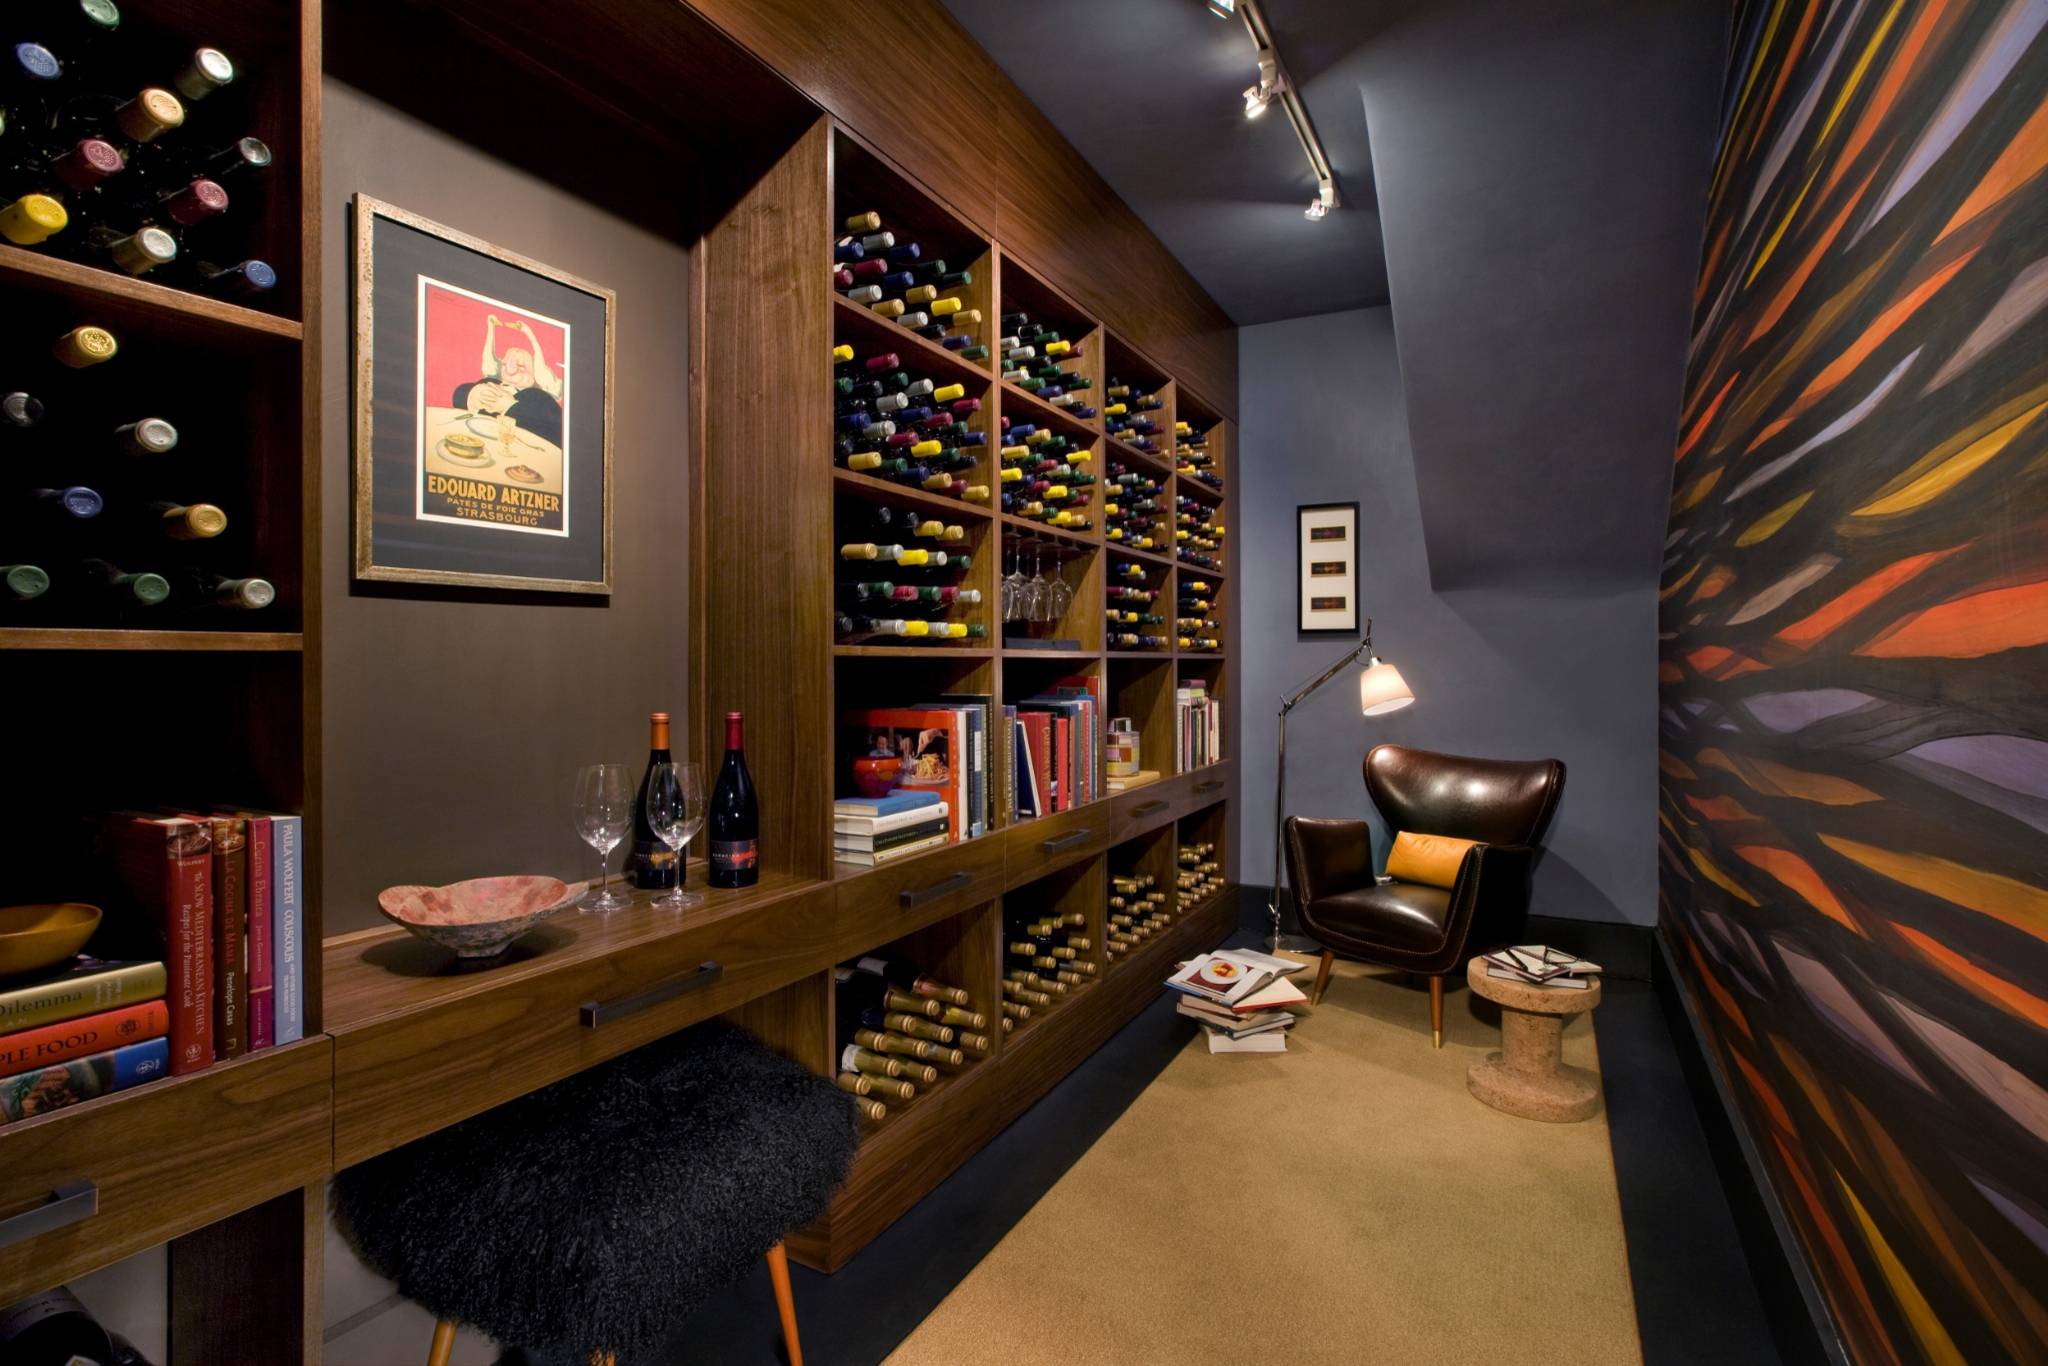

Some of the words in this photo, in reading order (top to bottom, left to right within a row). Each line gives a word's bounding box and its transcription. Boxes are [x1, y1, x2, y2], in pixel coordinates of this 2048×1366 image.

[428, 475, 496, 501] EDOUARD
[501, 487, 559, 512] ARTZNER
[456, 507, 537, 526] STRASBOURG
[480, 502, 493, 511] DE
[496, 505, 517, 514] FOIE
[519, 507, 545, 518] GRAS
[283, 824, 294, 856] PAULA
[255, 841, 266, 876] Cucina
[195, 882, 206, 909] SLOW
[225, 876, 236, 914] COCINA
[283, 858, 294, 905] WOLFERT
[255, 879, 266, 918] Ebraica
[179, 904, 193, 930] Recipes
[181, 929, 194, 943] for
[183, 943, 193, 955] the
[195, 911, 206, 990] MEDITERRANEAN
[284, 909, 295, 963] COUSCOUS
[183, 955, 193, 989] Passionate
[225, 971, 236, 1004] Penelope
[183, 990, 194, 1009] Cook
[195, 991, 207, 1036] KITCHEN
[225, 1004, 236, 1026] Casas
[37, 1031, 98, 1057] FOOD
